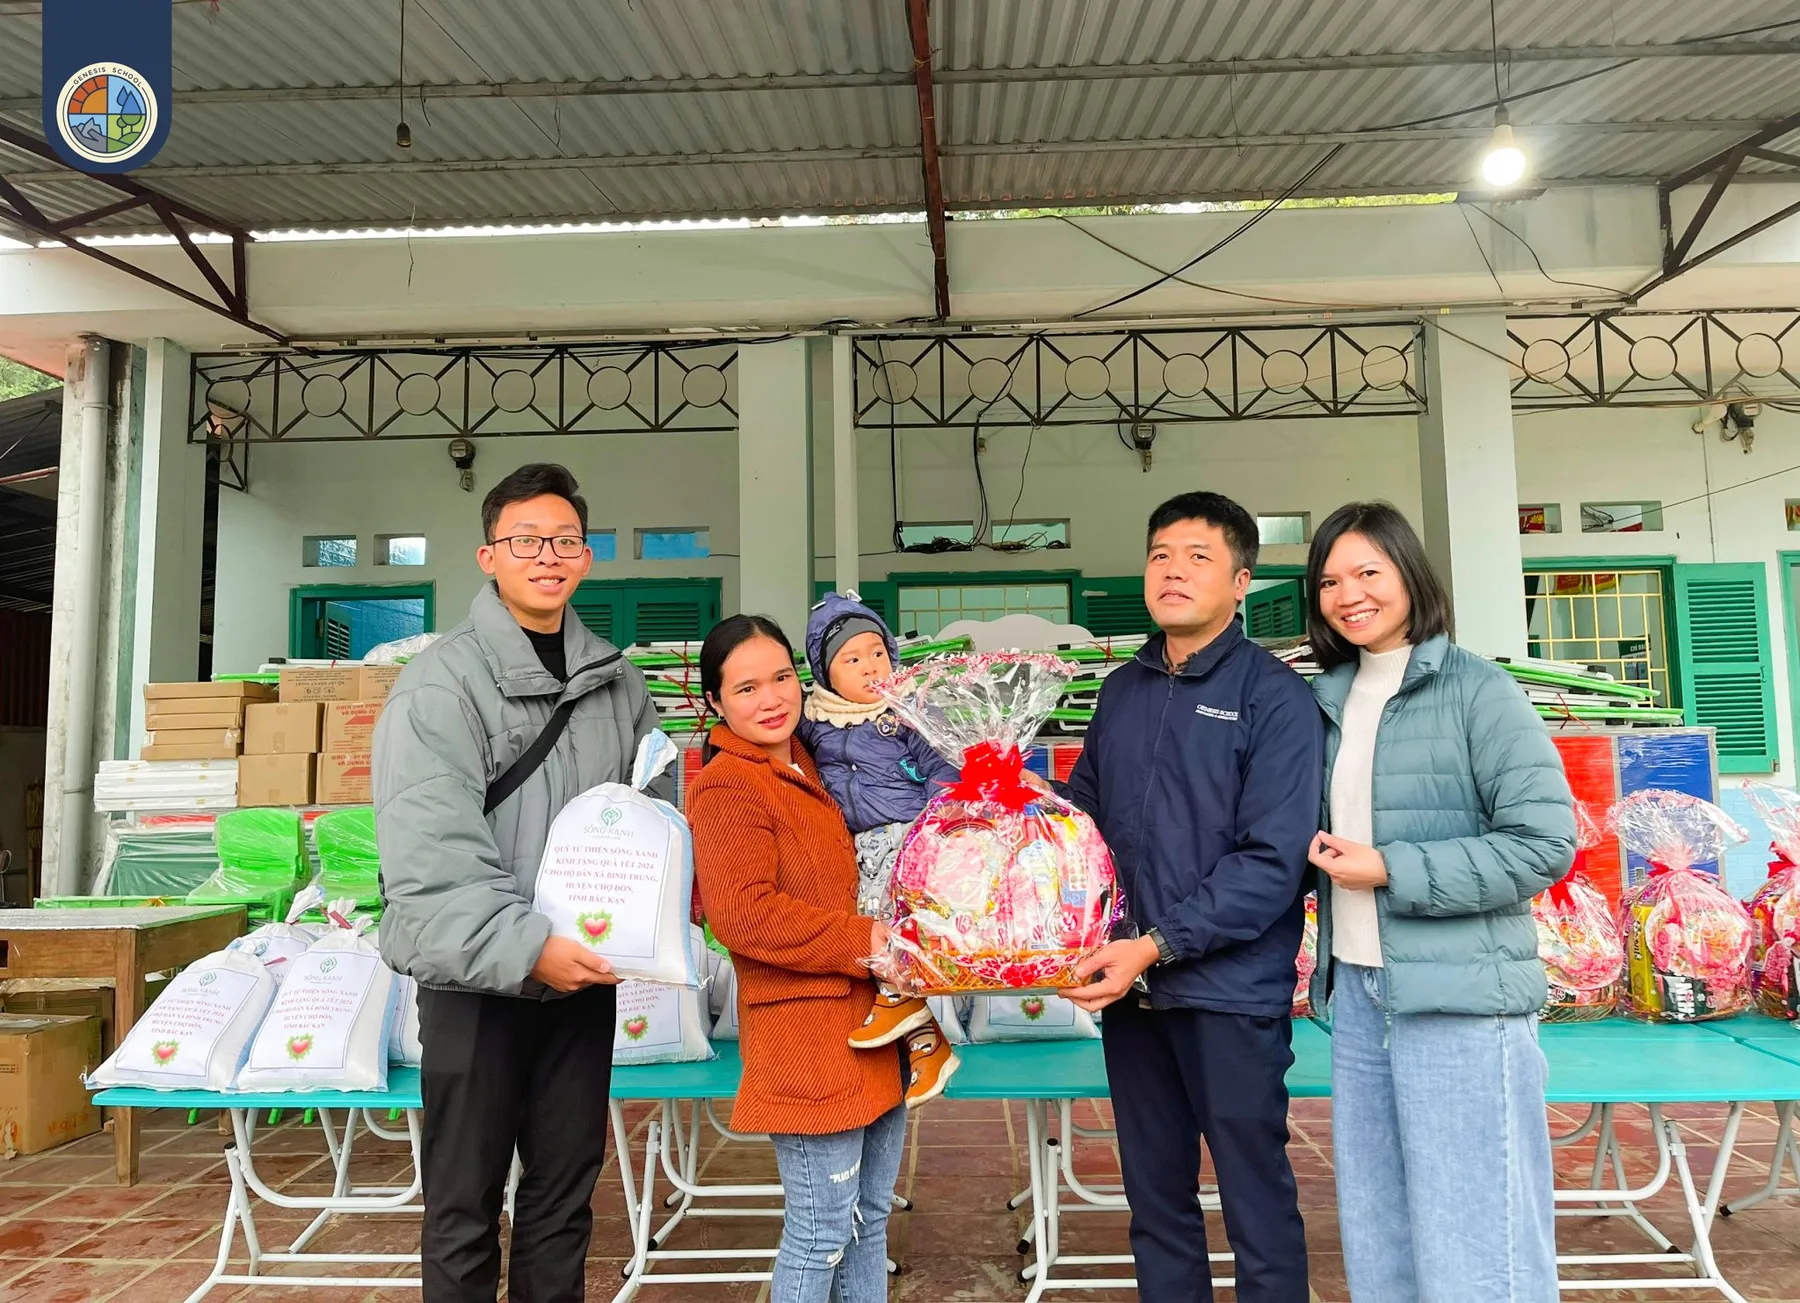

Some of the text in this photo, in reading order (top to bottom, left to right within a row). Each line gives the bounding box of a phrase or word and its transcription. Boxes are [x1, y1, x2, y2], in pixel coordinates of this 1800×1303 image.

[1197, 704, 1220, 715] GENESIS
[608, 828, 634, 838] XANH
[636, 850, 658, 858] XANH
[637, 862, 654, 870] 2024
[566, 882, 592, 890] HUYỆN
[594, 883, 612, 892] CHỢ
